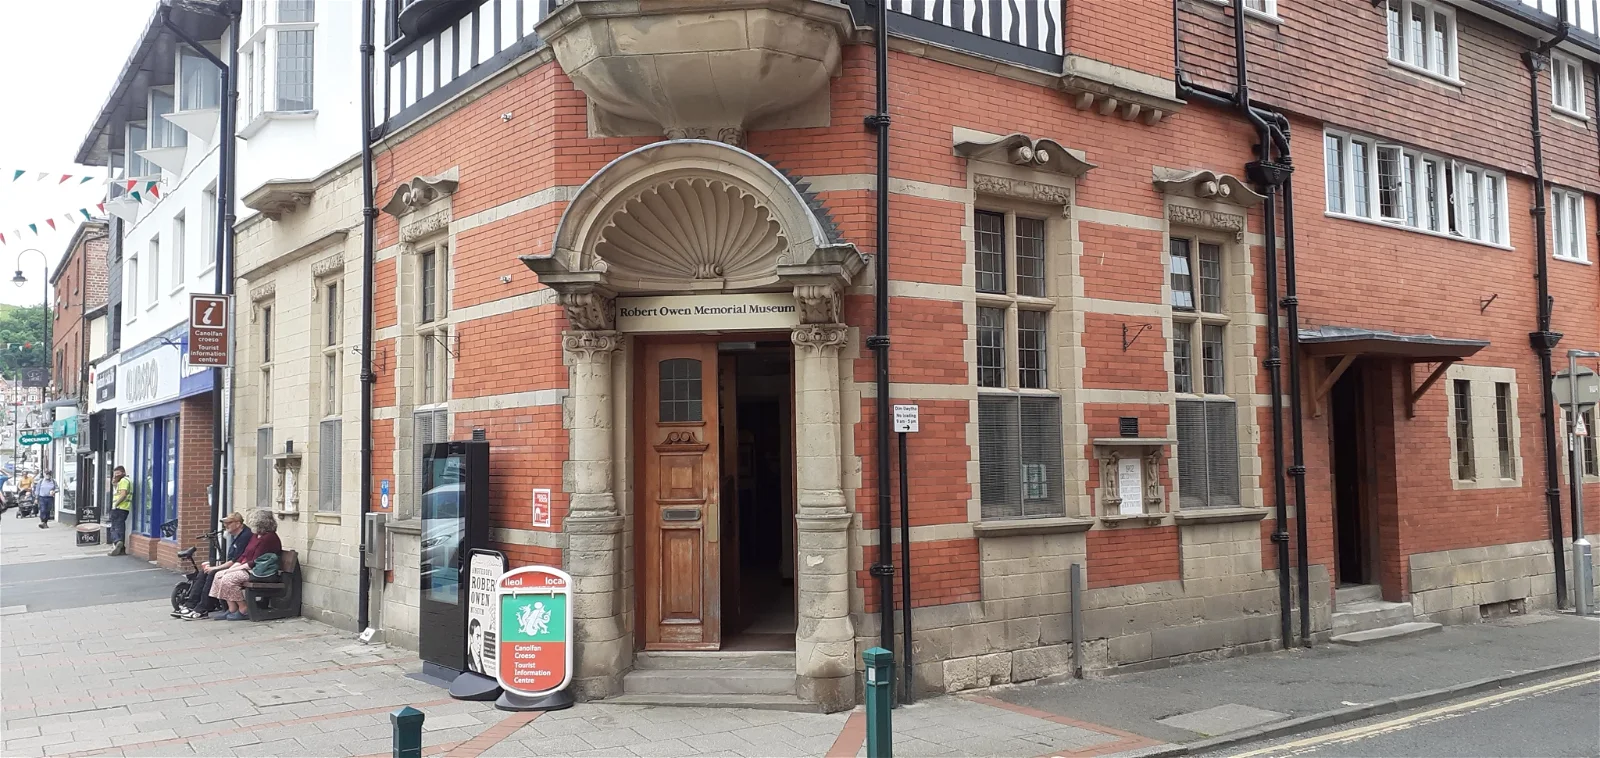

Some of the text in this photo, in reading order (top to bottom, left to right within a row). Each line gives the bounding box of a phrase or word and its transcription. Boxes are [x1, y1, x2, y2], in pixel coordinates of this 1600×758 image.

[620, 304, 796, 317] Robert Owen Memorial Museum
[471, 576, 497, 592] ROBER
[505, 577, 522, 586] lleol
[471, 592, 490, 606] OWEN
[514, 644, 542, 652] Canolfan
